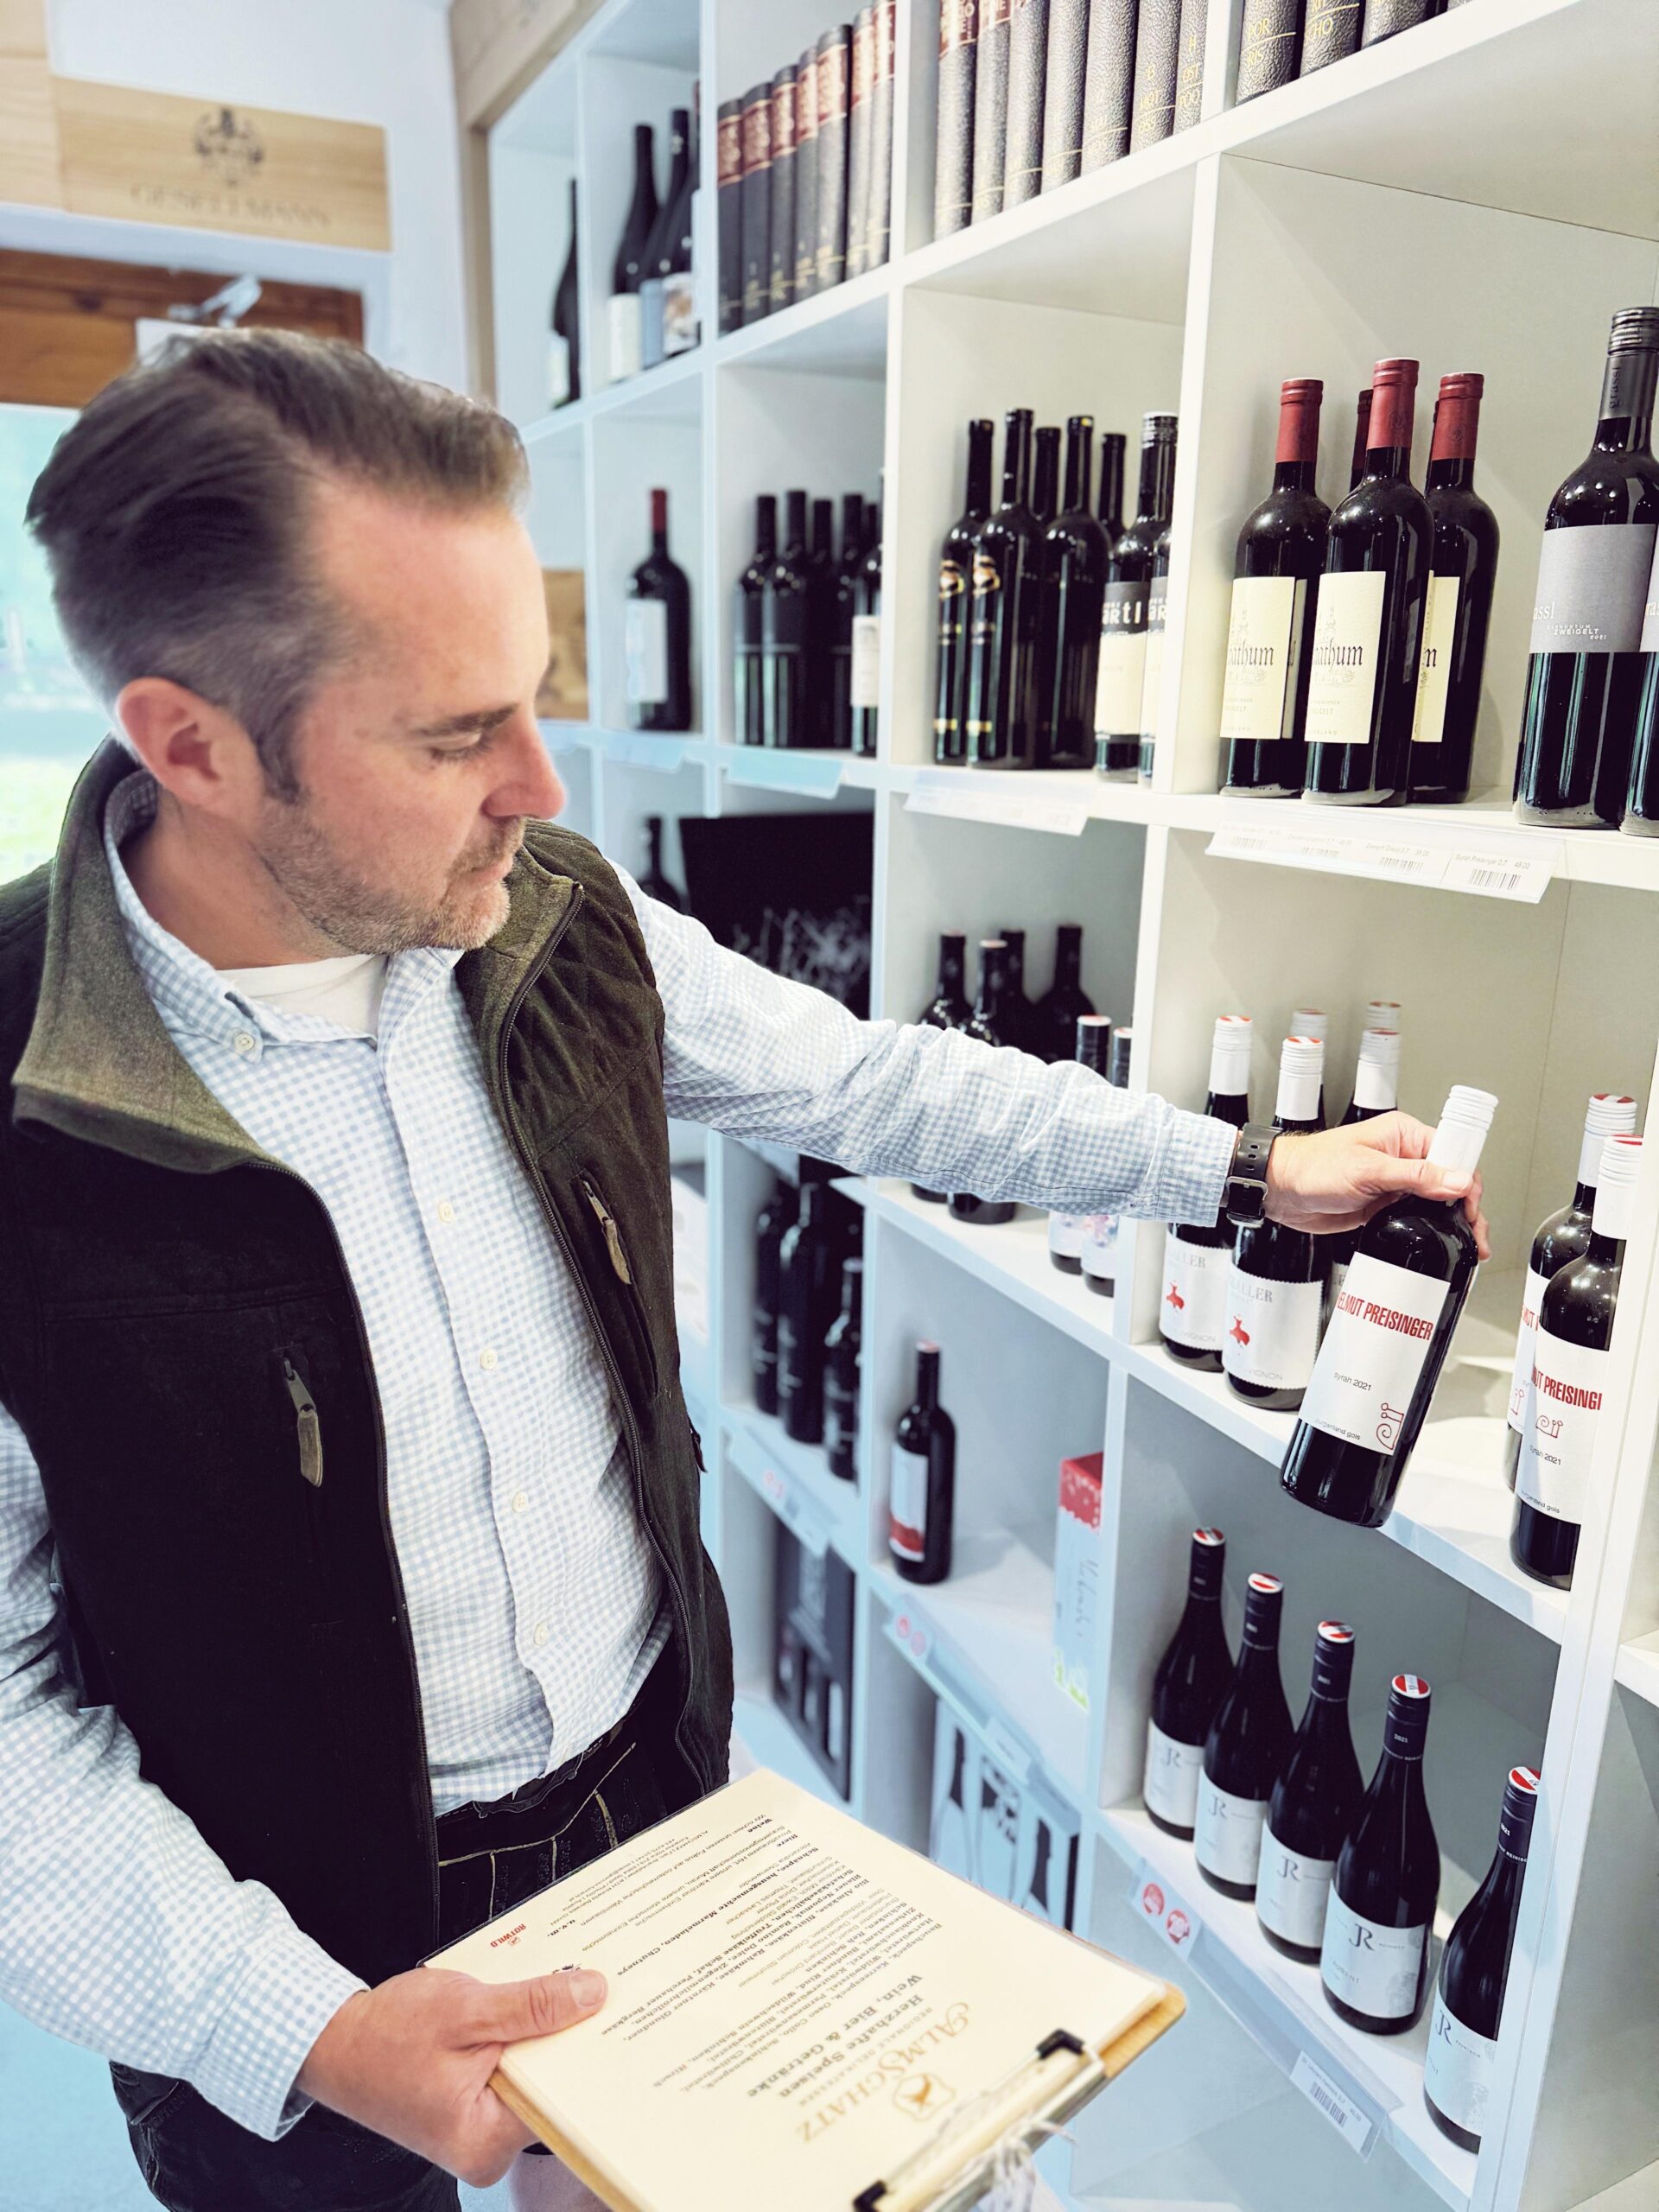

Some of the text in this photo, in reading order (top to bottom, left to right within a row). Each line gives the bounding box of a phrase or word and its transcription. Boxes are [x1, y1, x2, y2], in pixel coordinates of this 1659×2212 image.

[1610, 366, 1622, 410] grassl
[1533, 601, 1555, 620] assl
[1554, 627, 1599, 636] ZWEIGELT
[1227, 638, 1274, 671] athum
[1313, 637, 1363, 671] athum
[1363, 1301, 1434, 1341] PREISINGER
[1333, 1371, 1372, 1392] syrah 2021
[1543, 1452, 1562, 1466] 2021
[1393, 1732, 1409, 1744] 2021
[747, 1818, 772, 1833] Weine
[776, 1834, 798, 1847] Biere
[777, 1847, 819, 1872] Schnäpse,
[1505, 1850, 1528, 1863] REINISC
[718, 1872, 778, 1910] hausgemachte
[772, 1869, 854, 1921] Schafskäsebällchen,
[835, 1874, 861, 1892] Blauer
[791, 1891, 835, 1919] Nepomuk,
[815, 1888, 854, 1913] Almkäse,
[490, 1923, 526, 1948] ROTWILD
[547, 1919, 575, 1937] u.v.m.
[660, 1910, 717, 1946] Marmeladen,
[723, 1923, 772, 1955] Trüffelkäse
[758, 1920, 791, 1942] Ramino
[765, 1914, 816, 1947] Blütenkäse,
[805, 1902, 907, 1973] Schinken, Reh Schinken
[847, 1912, 925, 1965] Knoblauchwürstel,
[880, 1917, 933, 1954] Hartwürstel,
[1348, 1923, 1376, 1952] JR
[617, 1947, 661, 1976] Chutneys
[693, 1955, 723, 1974] Schaf,
[715, 1948, 766, 1980] Rahmkäse,
[728, 1942, 758, 1961] Dolce,
[826, 1955, 881, 1992] Wildwürstel,
[876, 1974, 923, 2002] Wein,
[646, 1974, 693, 2006] Perchauer
[653, 1906, 917, 2088] Zirbensalami, Bündner Rind, Wildschwein Schinken, Hirsch
[673, 1981, 715, 2011] Kärntner
[777, 1967, 847, 2014] Kräuterwürstel,
[702, 1923, 943, 2088] Bauchspeck, Karreespeck, Osso Collo, Schinkenspeck,
[745, 1993, 827, 2048] Parmesanwürstel,
[843, 2005, 877, 2031] Bier
[601, 2006, 645, 2036] Bergkäse
[623, 2011, 672, 2041] Glundner,
[1434, 2009, 1453, 2047] JR
[779, 1994, 924, 2098] Herzhafte Speisen
[798, 2006, 933, 2107] REGIONALE DELIKATESSEN
[747, 2044, 824, 2097] Getränke
